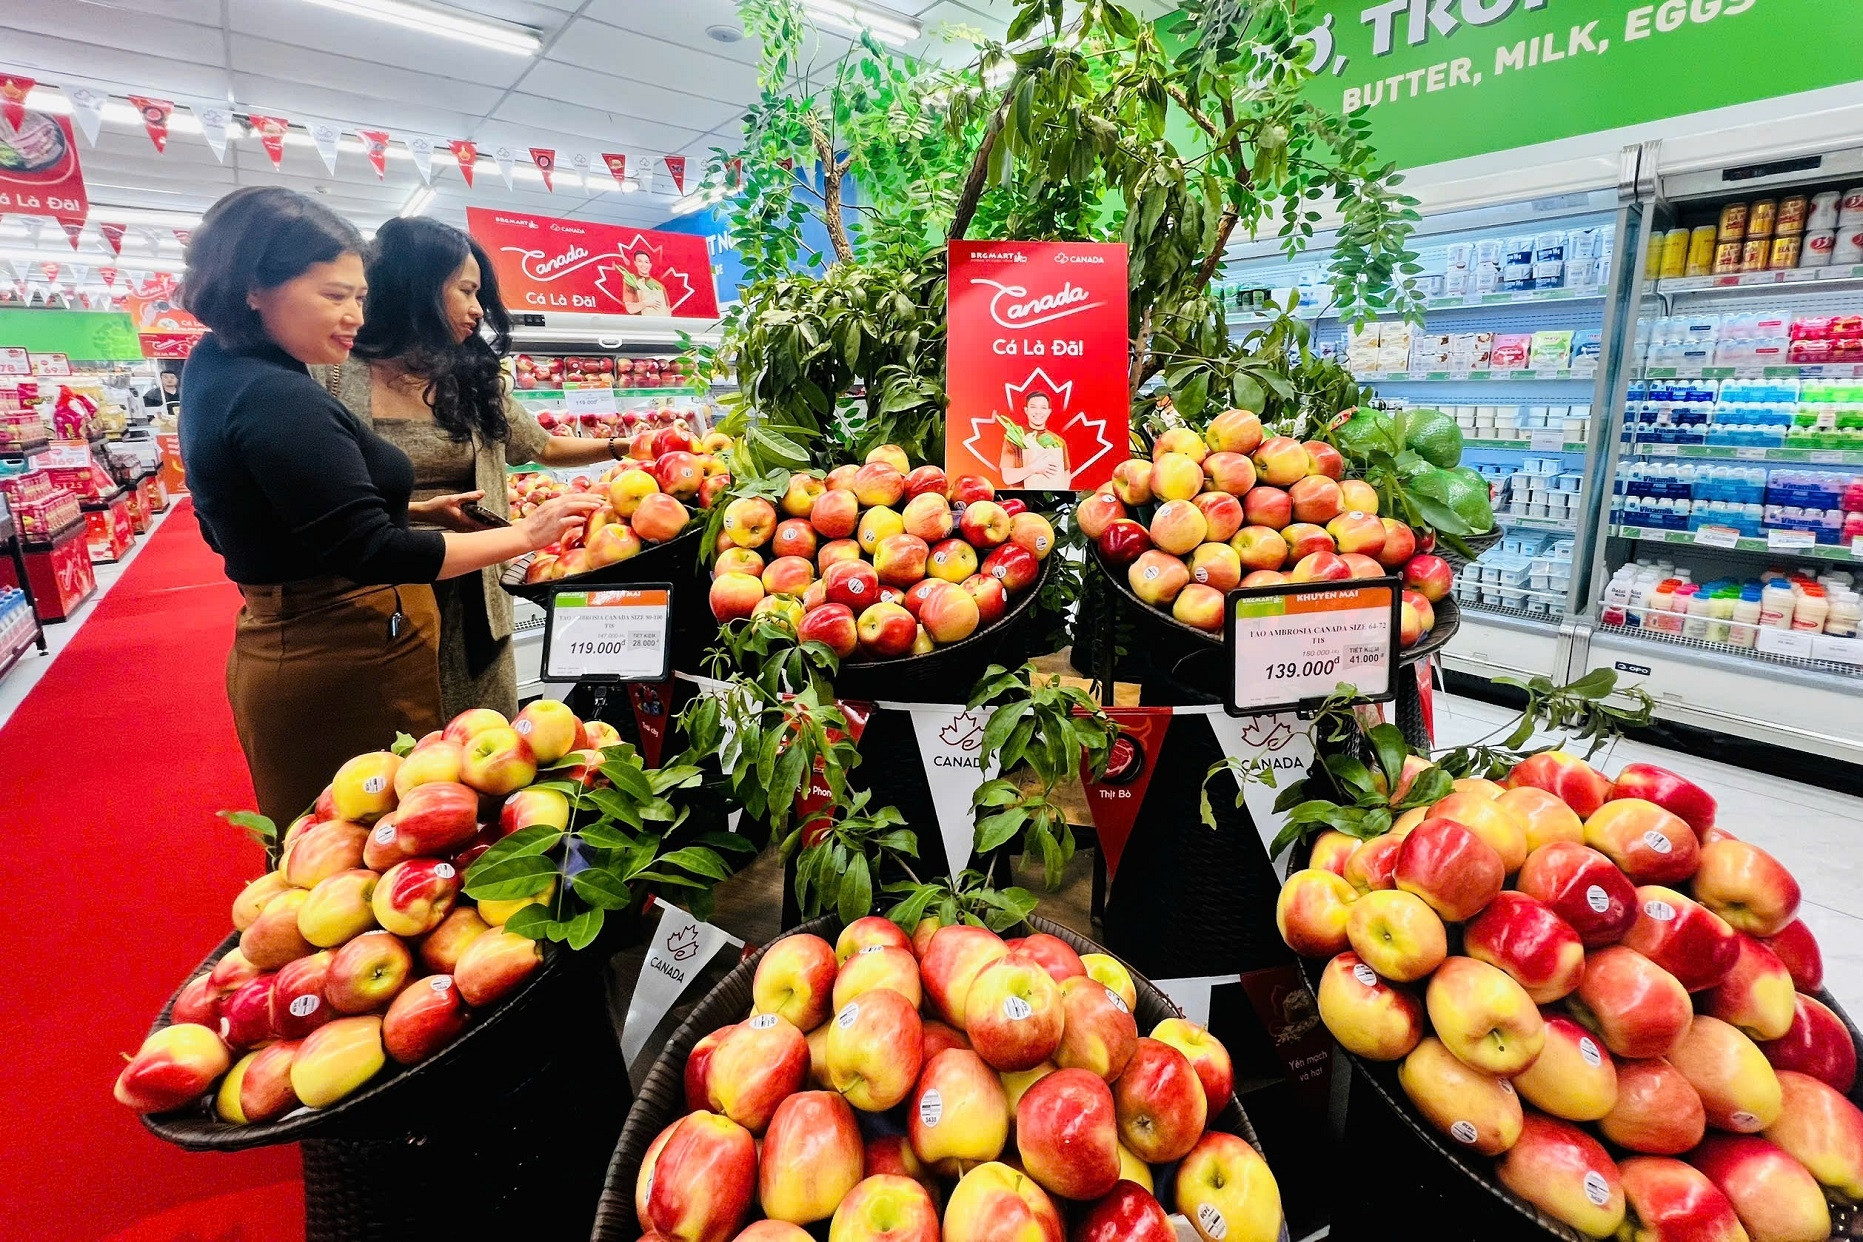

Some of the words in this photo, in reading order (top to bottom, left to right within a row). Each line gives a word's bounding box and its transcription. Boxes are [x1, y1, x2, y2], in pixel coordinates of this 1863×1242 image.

[1342, 57, 1482, 115] BUTTER,
[1494, 19, 1609, 76] MILK,
[16, 194, 41, 208] Là
[47, 196, 80, 212] Đã!
[970, 252, 1014, 260] BRGMART
[1069, 256, 1105, 264] CANADA
[525, 291, 547, 305] Cá
[550, 292, 568, 306] Là
[571, 294, 597, 308] Đã!
[972, 280, 1096, 329] Canada
[992, 339, 1018, 355] Cá
[1023, 339, 1045, 356] Là
[1051, 339, 1084, 356] Đã!
[1665, 385, 1698, 393] Vinamilk
[1653, 427, 1688, 435] Vinamilk
[1643, 475, 1679, 484] Vinamilk
[1782, 482, 1822, 492] Vinamilk
[1639, 505, 1674, 516] Vinamilk
[1780, 516, 1824, 528] Vinamilk
[1269, 626, 1312, 637] AMBROSIA
[1313, 625, 1347, 635] CANADA
[1628, 664, 1649, 675] OPO
[933, 755, 992, 769] CANAD
[1099, 789, 1116, 800] Thịt
[1118, 789, 1132, 798] Bò
[650, 956, 685, 984] CANADA
